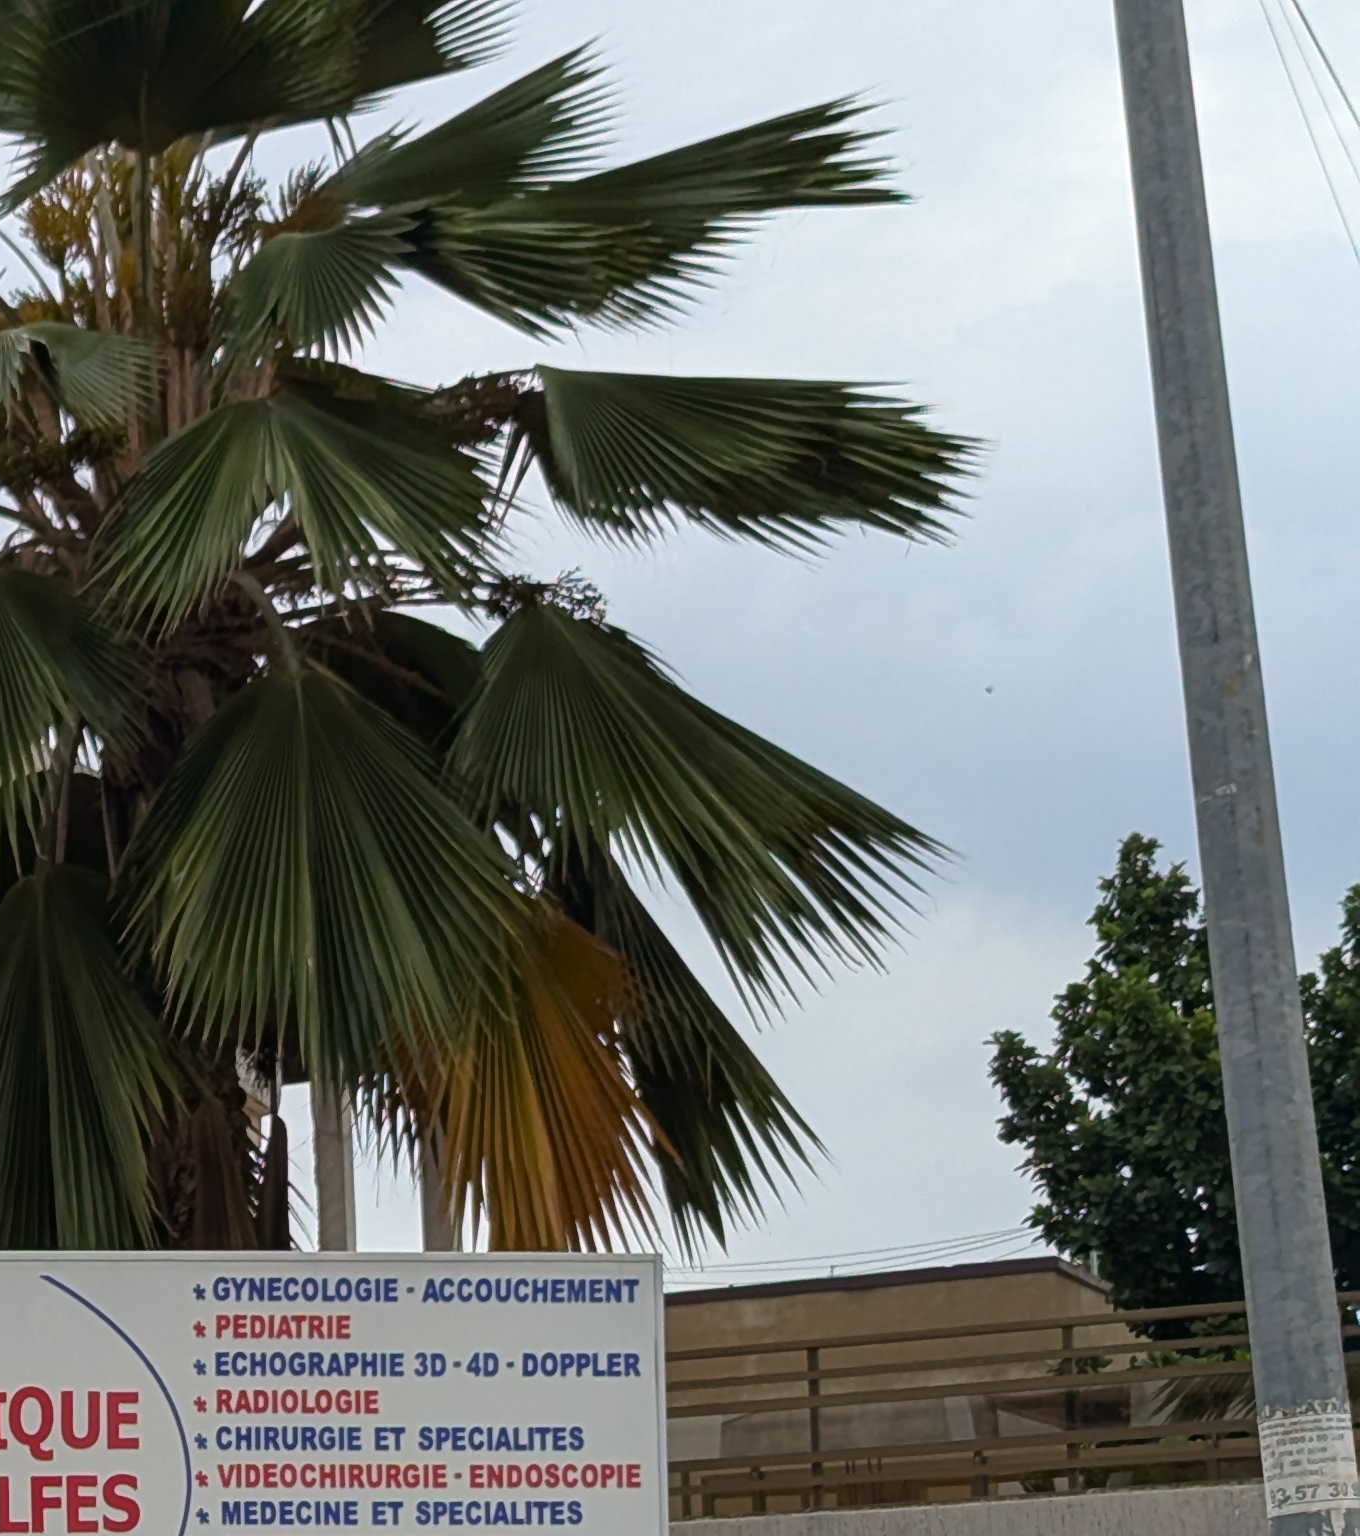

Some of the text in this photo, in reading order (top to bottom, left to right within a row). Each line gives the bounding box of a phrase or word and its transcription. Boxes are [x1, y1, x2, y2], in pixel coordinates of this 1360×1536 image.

[212, 1277, 398, 1302] GYNECOLOGIE
[421, 1278, 640, 1303] ACCOUCHEMENT
[214, 1314, 352, 1340] PEDIATRIE
[214, 1352, 405, 1377] ECHOGRAPHIE
[414, 1352, 446, 1377] 3D
[467, 1352, 500, 1377] 4D
[521, 1352, 641, 1377] DOPPLER
[215, 1389, 380, 1414] RADIOLOGIE
[215, 1426, 585, 1451] CHIRURGIE ET SPECIALITES
[218, 1464, 448, 1489] VIDEOCHIRURGIE
[469, 1464, 642, 1489] ENDOSCOPIE
[221, 1501, 583, 1526] MEDECINE ET SPECIALITES
